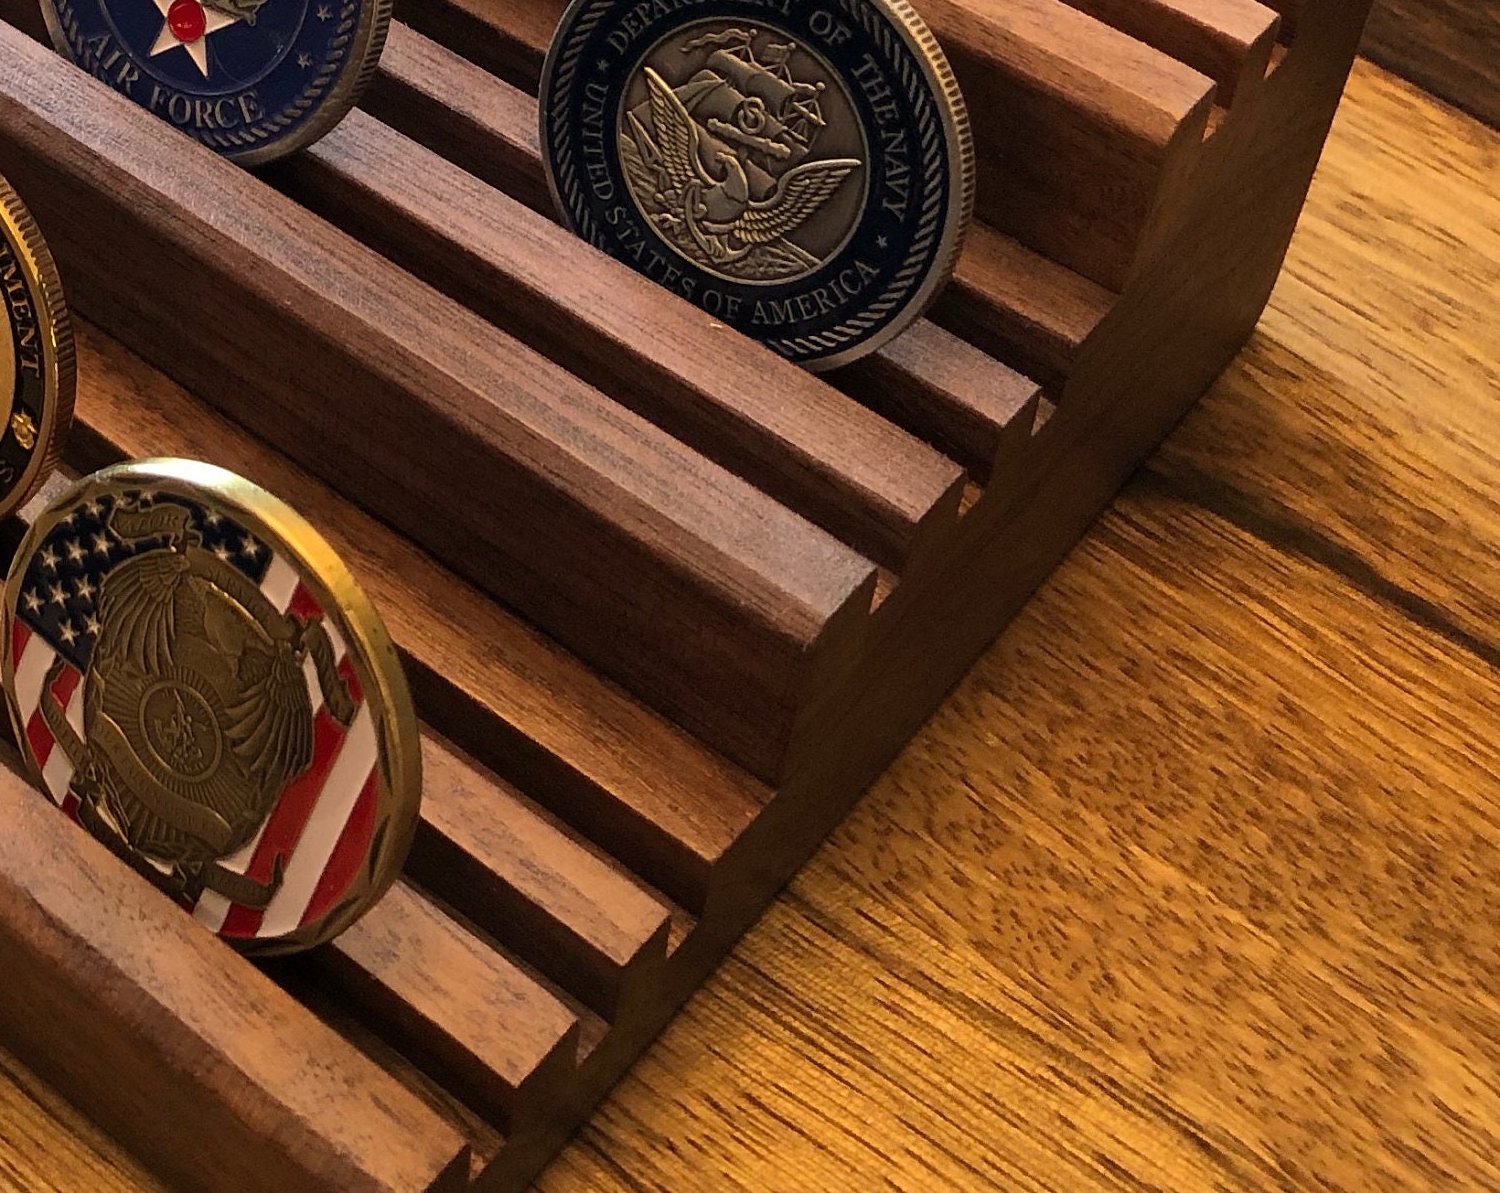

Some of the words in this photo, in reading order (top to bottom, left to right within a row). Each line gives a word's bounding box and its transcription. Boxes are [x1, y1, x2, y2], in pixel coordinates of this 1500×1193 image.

[87, 35, 141, 93] AIR
[150, 90, 264, 129] FORCE
[809, 10, 853, 49] OF
[850, 53, 896, 130] THE
[882, 133, 913, 224] NAVY
[582, 78, 615, 202] UNITED
[604, 205, 698, 299] STATES
[702, 289, 744, 321] OF
[750, 259, 880, 327] AMERICA
